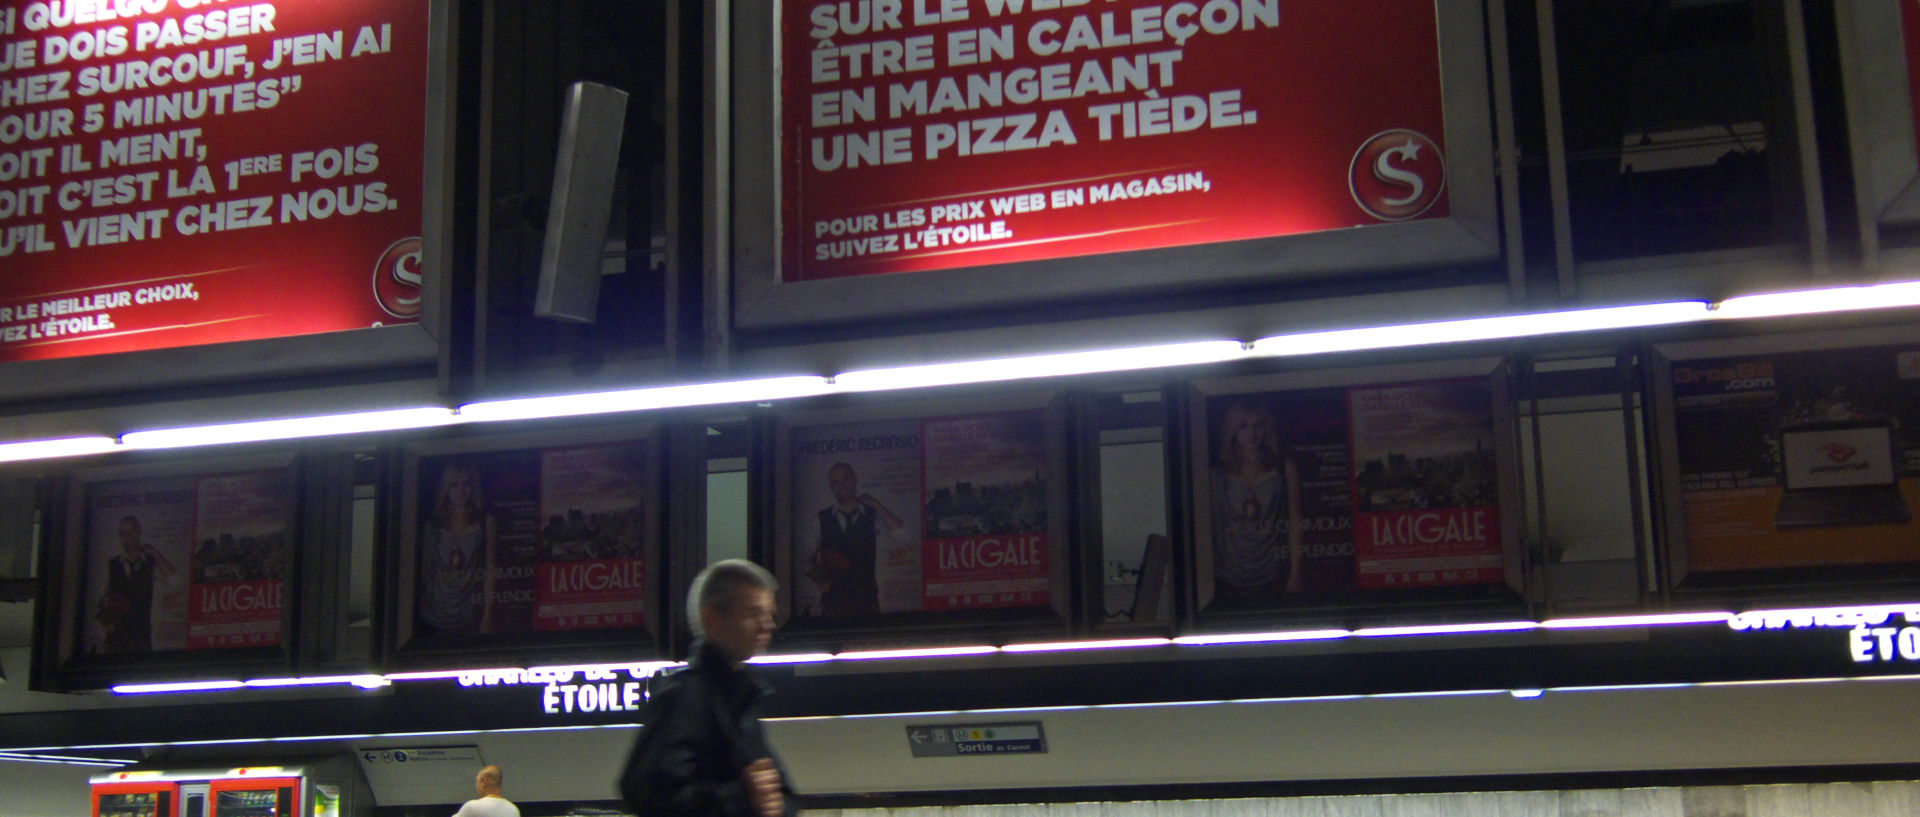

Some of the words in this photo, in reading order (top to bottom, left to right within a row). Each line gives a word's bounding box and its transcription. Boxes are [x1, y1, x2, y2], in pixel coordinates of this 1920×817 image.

[0, 7, 16, 35] I
[23, 0, 228, 31] QUELQ
[43, 26, 129, 66] DOIS
[136, 4, 276, 51] PASSER
[809, 0, 903, 39] SUR
[914, 0, 970, 26] LE
[811, 39, 935, 84] ÊTRE
[947, 24, 1014, 67] EN
[1027, 0, 1279, 57] CALEÇON
[0, 71, 71, 107] HEZ
[77, 44, 255, 96] SURCOUF,
[262, 31, 342, 71] J’EN
[350, 23, 392, 57] AI
[811, 86, 876, 128] EN
[889, 50, 1183, 119] MANGEANT
[0, 108, 74, 144] OUR
[82, 103, 104, 133] 5
[113, 75, 302, 129] MINUTES”
[811, 127, 913, 172] UNE
[925, 109, 1078, 160] PIZZA
[1088, 88, 1257, 141] TIÈDE.
[0, 147, 53, 181] OIT
[61, 144, 92, 173] IL
[100, 127, 207, 168] MENT,
[0, 185, 51, 219] OIT
[58, 171, 160, 211] C’EST
[167, 165, 216, 198] LA
[224, 153, 283, 191] 1ERE
[290, 142, 380, 183] FOIS
[0, 223, 55, 257] U’IL
[62, 208, 169, 249] VIENT
[175, 195, 274, 236] CHEZ
[280, 181, 398, 224] NOUS.
[815, 215, 878, 238] POUR
[883, 209, 926, 230] LES
[930, 201, 985, 224] PRIX
[989, 194, 1046, 217] WEB
[1052, 189, 1083, 209] EN
[1089, 171, 1211, 204] MAGASIN,
[815, 236, 898, 260] SUIVEZ
[904, 220, 1013, 249] L'ÉTOILE.
[16, 303, 39, 321] LE
[41, 291, 131, 317] MEILLEUR
[134, 282, 199, 305] CHOIX,
[30, 313, 116, 339] L'ÉTOILE.
[1724, 377, 1776, 390] .com
[1372, 516, 1395, 547] LA
[1396, 511, 1486, 544] CIGALE
[939, 541, 957, 570] LA
[960, 536, 1041, 568] CIGALE
[1293, 542, 1354, 557] PLENDID
[551, 566, 568, 593] LA
[570, 560, 643, 592] CIGALE
[202, 587, 217, 613] LA
[220, 583, 283, 612] CIGALE
[1849, 622, 1920, 662] ÉTO
[543, 680, 640, 714] ÉTOILE
[958, 743, 993, 753] Sortie
